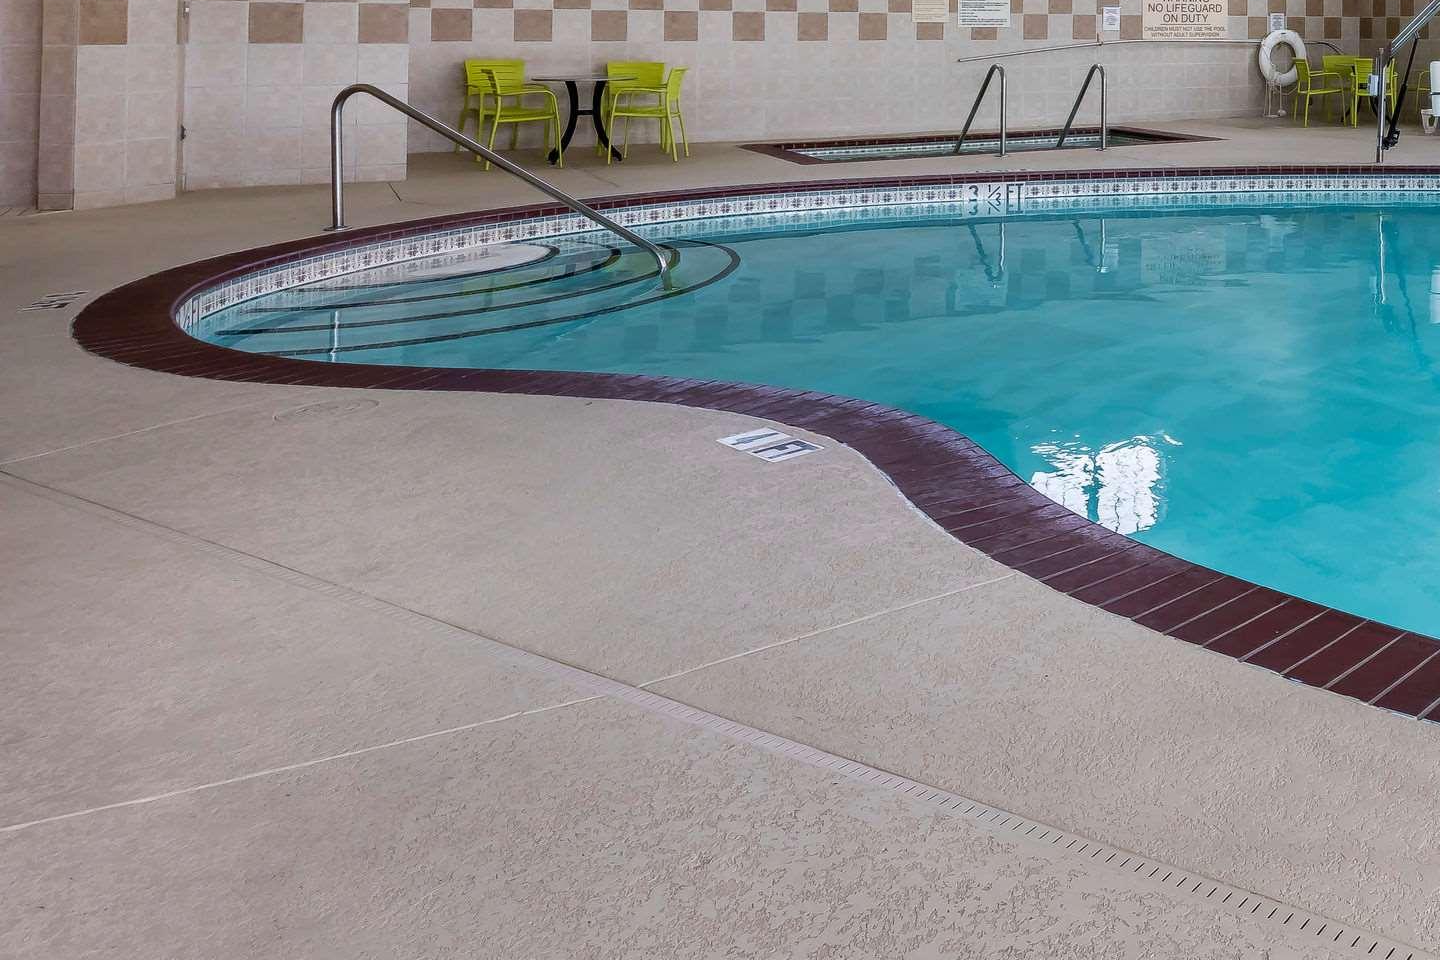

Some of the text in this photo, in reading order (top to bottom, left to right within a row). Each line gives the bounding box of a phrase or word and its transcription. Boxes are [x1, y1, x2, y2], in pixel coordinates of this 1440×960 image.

[1147, 3, 1223, 13] NO LIFEGUARD
[1162, 13, 1209, 23] ON DUTY
[1006, 183, 1024, 199] FT
